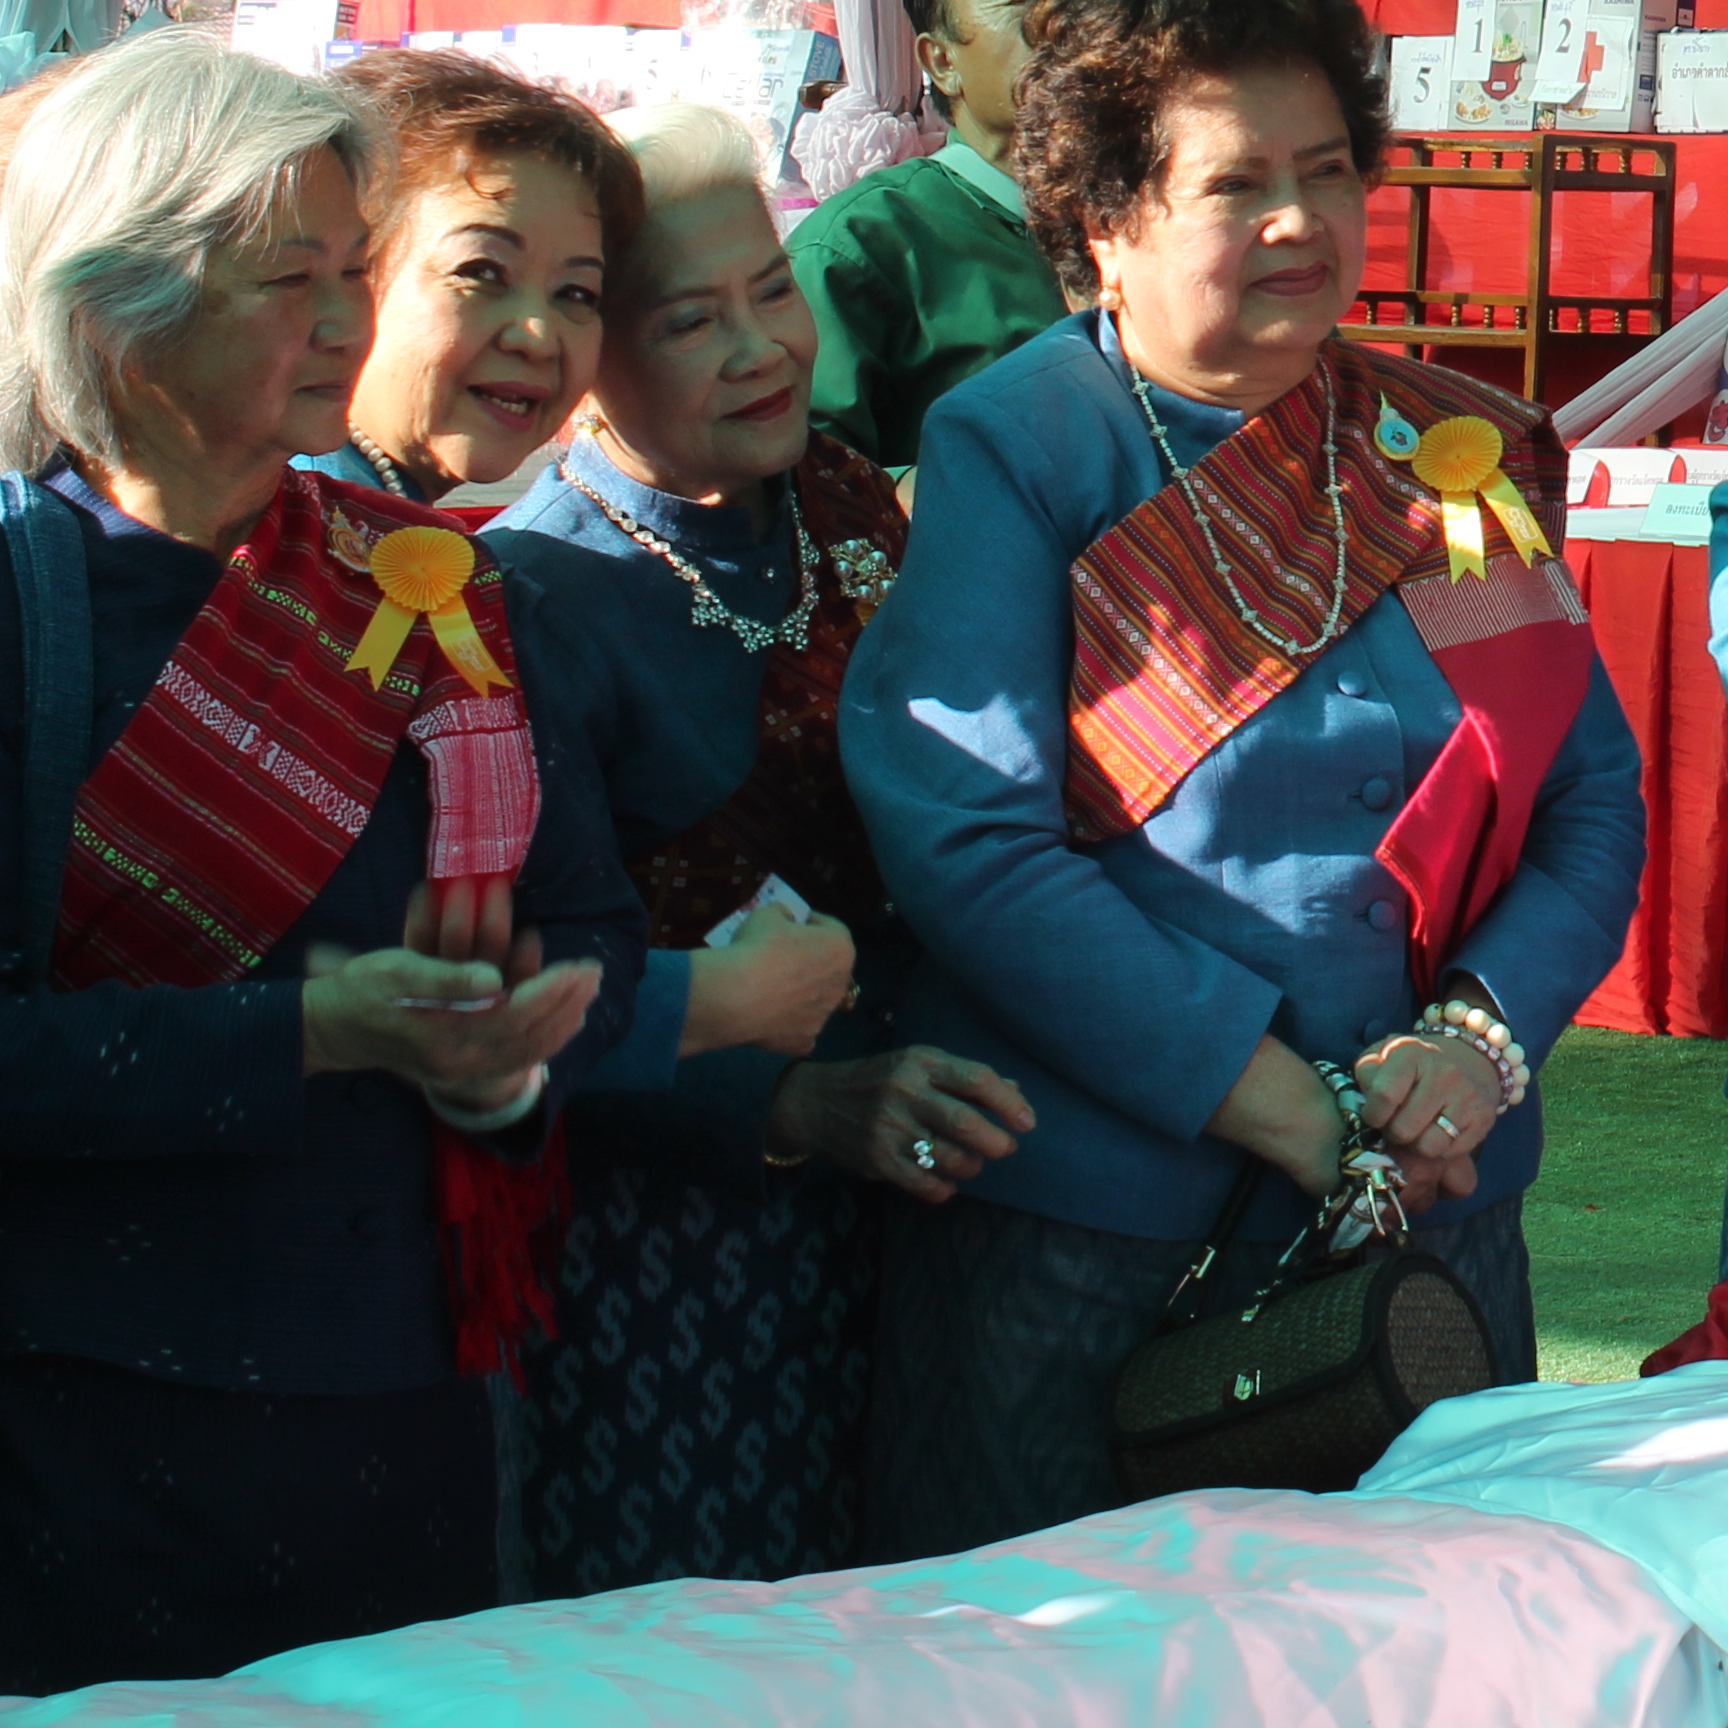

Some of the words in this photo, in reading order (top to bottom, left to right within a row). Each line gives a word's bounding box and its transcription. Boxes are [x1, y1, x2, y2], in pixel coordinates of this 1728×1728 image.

[1471, 18, 1484, 54] 1
[1554, 18, 1572, 54] 2
[1413, 66, 1432, 104] 5
